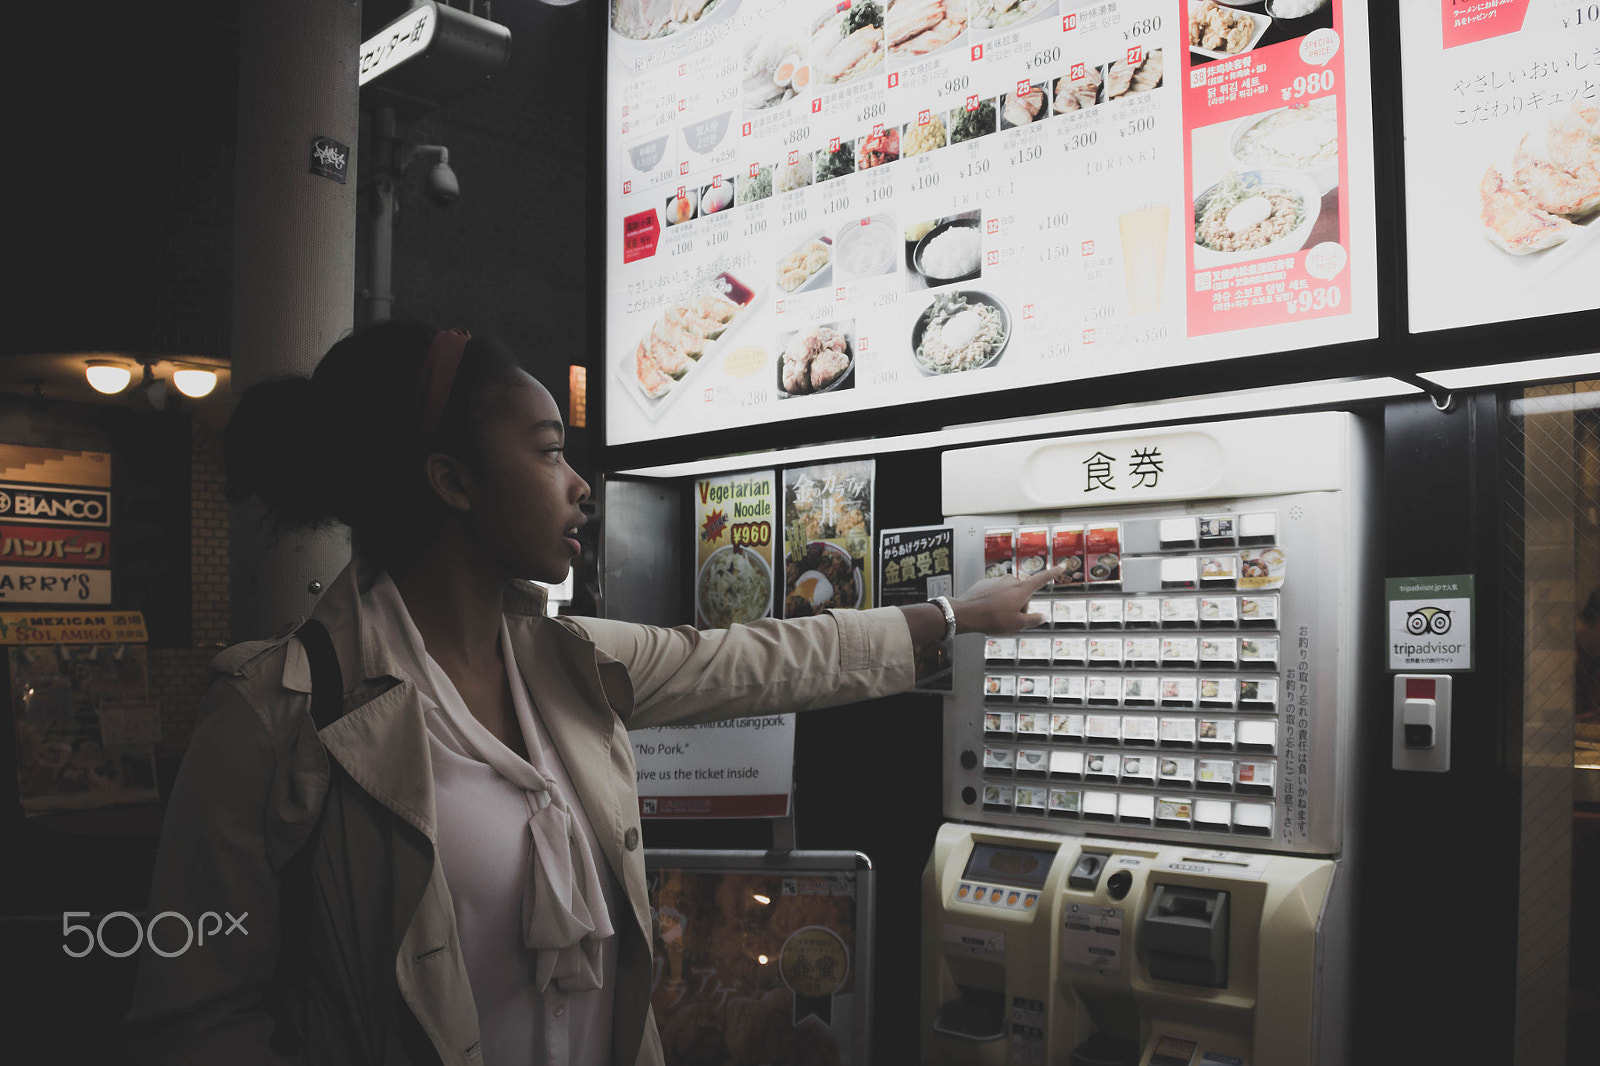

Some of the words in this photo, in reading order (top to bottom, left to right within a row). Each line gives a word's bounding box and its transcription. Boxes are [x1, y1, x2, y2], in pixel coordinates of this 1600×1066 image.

[1123, 16, 1161, 40] ¥680
[1303, 36, 1335, 50] SPECIAL
[1026, 47, 1060, 70] ¥680
[1128, 48, 1141, 62] 27
[1308, 48, 1331, 58] PRICE
[1071, 66, 1083, 79] 26
[938, 75, 969, 97] ¥980
[1018, 82, 1030, 95] 25
[1281, 69, 1335, 101] ¥980
[857, 102, 886, 122] ¥880
[967, 97, 979, 110] 24
[919, 112, 930, 124] 23
[1120, 116, 1155, 138] ¥500
[784, 126, 810, 146] ¥880
[873, 126, 884, 138] 22
[1064, 131, 1097, 151] ¥300
[830, 140, 840, 152] 21
[1010, 145, 1042, 165] ¥150
[788, 153, 799, 165] 20
[750, 165, 760, 178] 19
[960, 159, 990, 178] ¥150
[911, 172, 940, 191] ¥100
[678, 187, 688, 200] 17
[866, 185, 893, 203] ¥100
[824, 197, 849, 214] ¥100
[783, 208, 807, 226] ¥100
[1039, 212, 1069, 230] ¥100
[744, 220, 767, 236] ¥100
[988, 220, 999, 233] 32
[706, 231, 729, 247] ¥100
[672, 241, 693, 256] ¥100
[1039, 244, 1069, 264] ¥150
[1287, 286, 1341, 314] ¥930
[1082, 446, 1163, 492] 食券
[699, 477, 771, 505] Vegetarian
[15, 496, 103, 519] BIANCO
[734, 500, 771, 519] Noodle
[733, 524, 769, 545] ¥960
[884, 531, 950, 560] からあげグランプリ
[885, 546, 950, 585] 金賞受賞
[30, 617, 106, 627] MEXICAN
[16, 626, 57, 641] SOL
[60, 627, 112, 641] AMIGO
[1393, 641, 1463, 658] tripadvisor
[737, 719, 761, 731] using
[659, 772, 671, 780] us
[674, 768, 692, 780] the
[695, 768, 724, 780] ticket
[727, 767, 759, 779] inside
